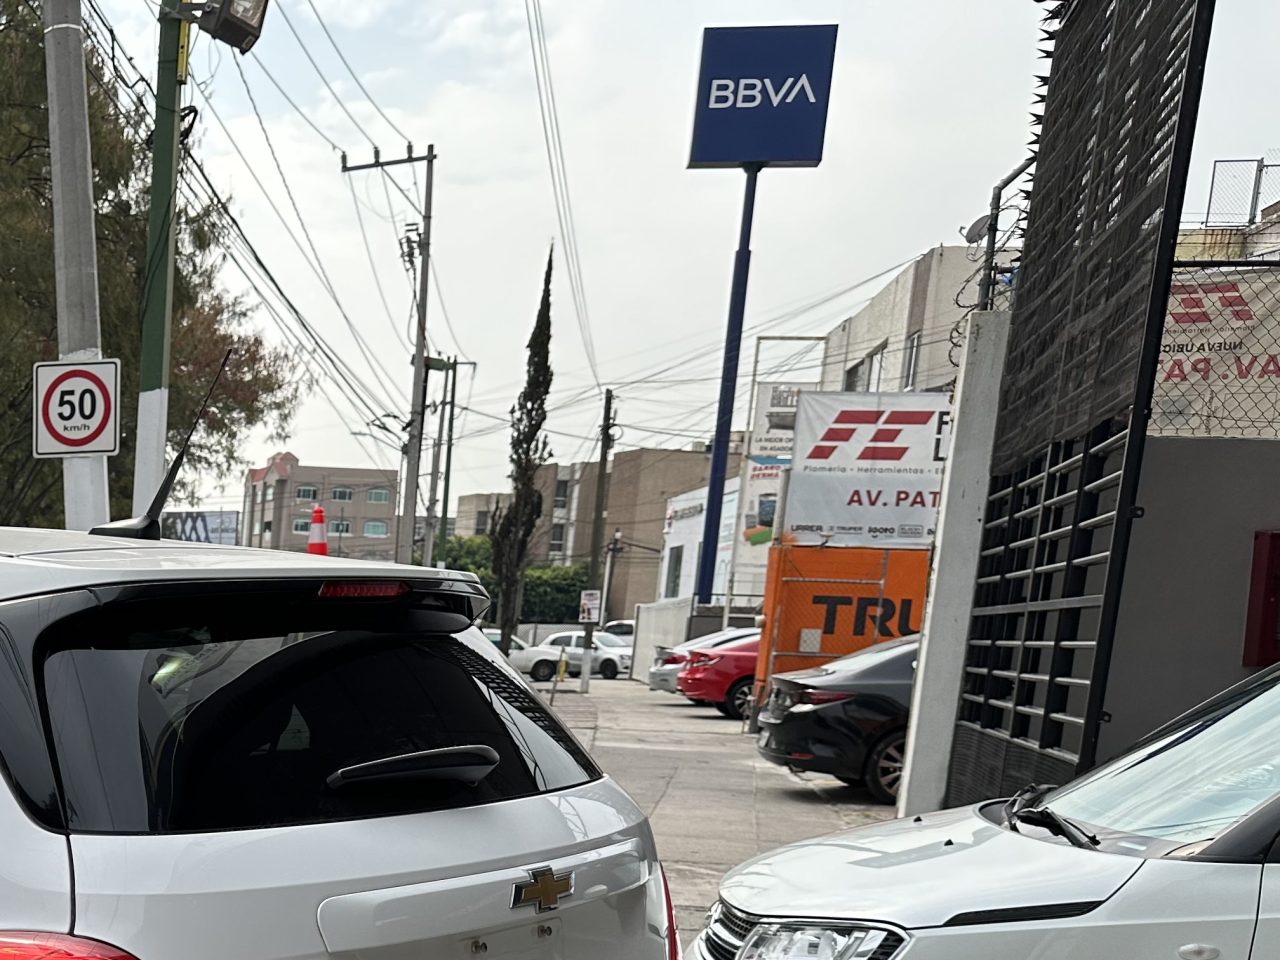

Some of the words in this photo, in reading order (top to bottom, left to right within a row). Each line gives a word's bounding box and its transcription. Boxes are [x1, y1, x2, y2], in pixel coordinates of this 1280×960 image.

[708, 73, 817, 109] BBVA
[57, 388, 97, 421] 50
[63, 423, 91, 432] km/h
[857, 466, 925, 475] Herramientas
[846, 489, 889, 507] AV.
[894, 490, 941, 508] PAT
[812, 595, 921, 638] TRU
